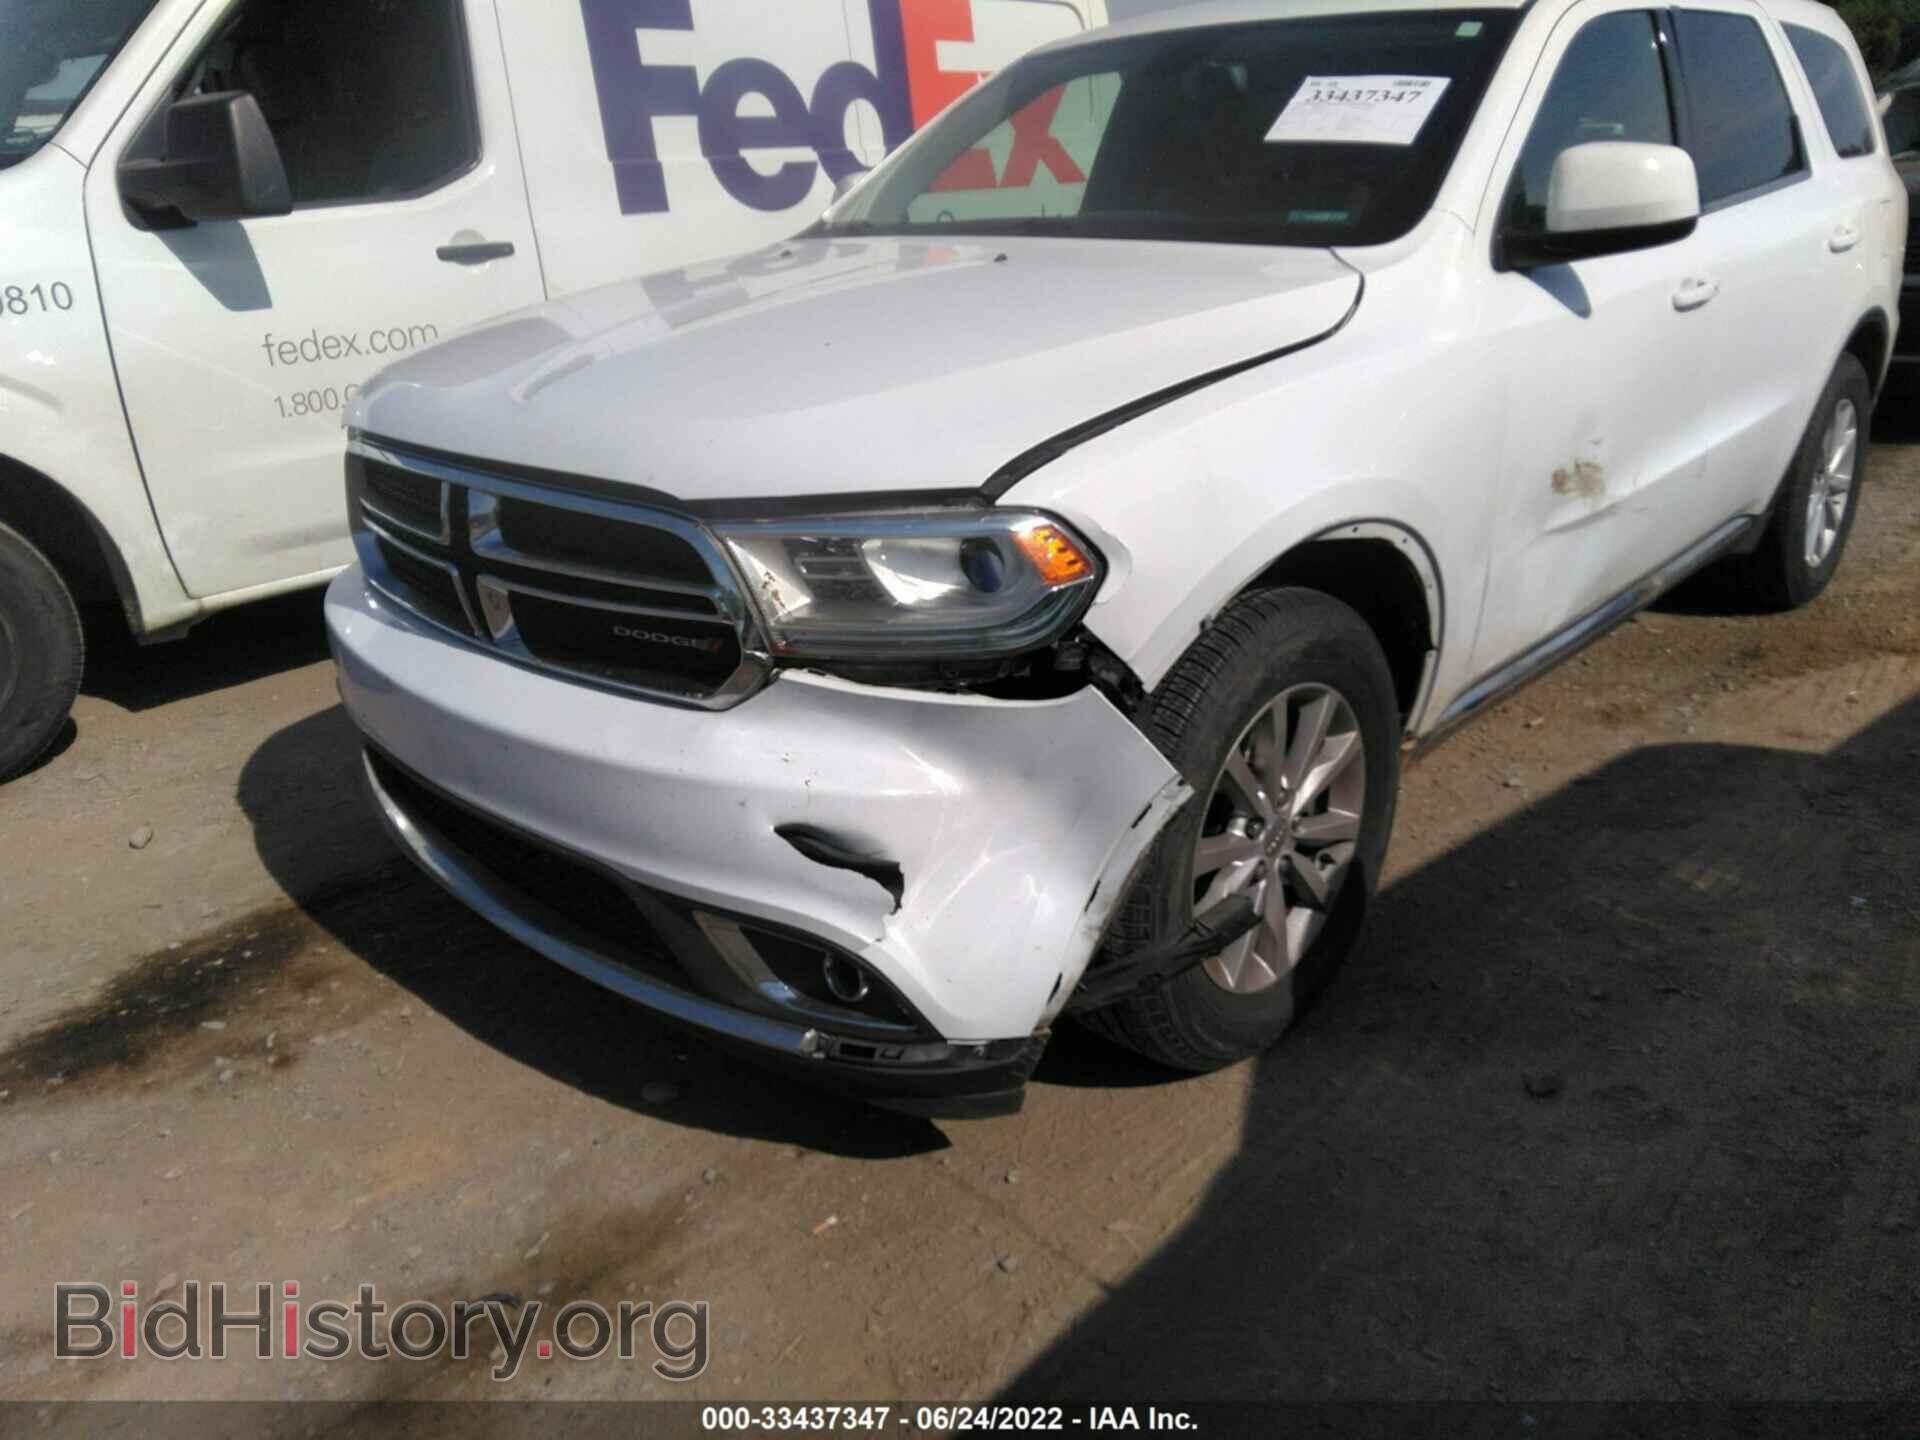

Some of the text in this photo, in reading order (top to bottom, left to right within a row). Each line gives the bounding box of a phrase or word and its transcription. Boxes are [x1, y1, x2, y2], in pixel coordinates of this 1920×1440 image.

[1305, 88, 1423, 104] 33437347
[0, 281, 74, 318] 810
[262, 323, 439, 367] fedex.com
[612, 625, 704, 649] DODGE
